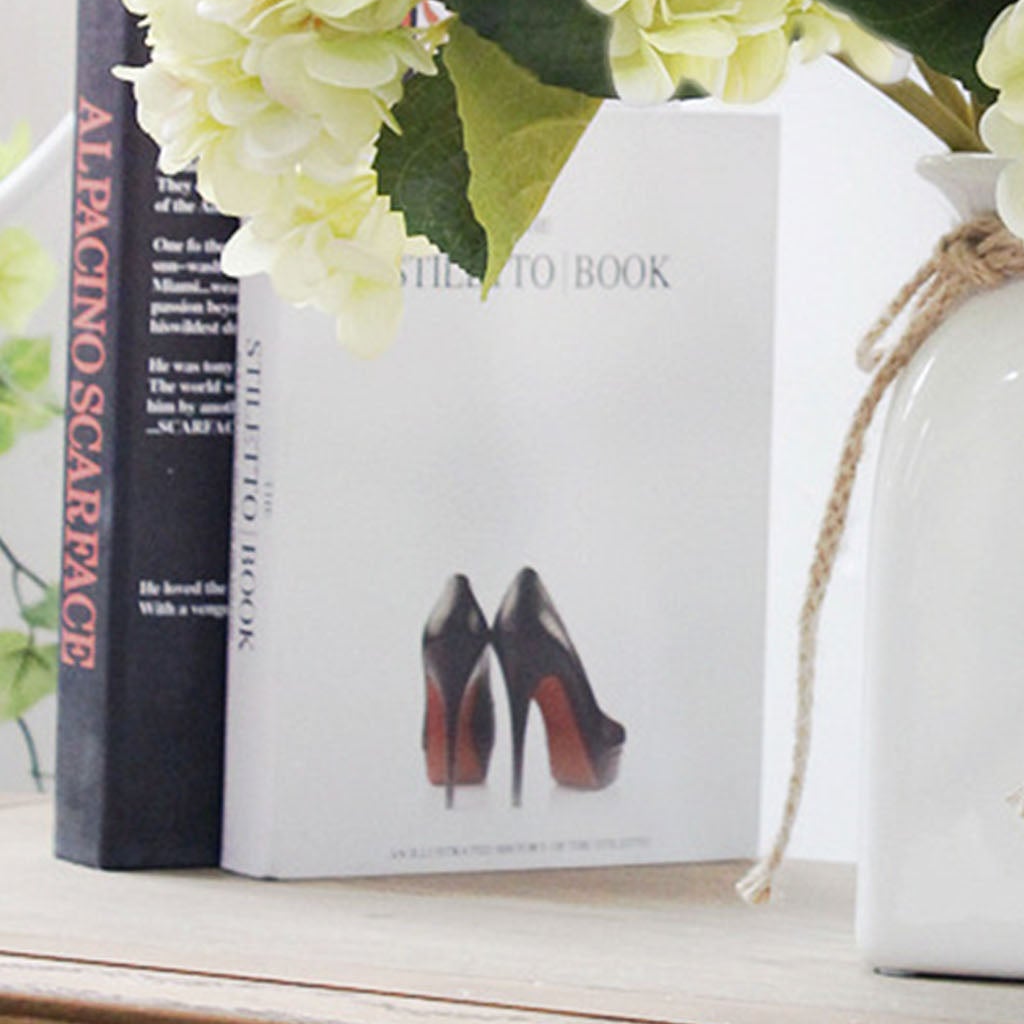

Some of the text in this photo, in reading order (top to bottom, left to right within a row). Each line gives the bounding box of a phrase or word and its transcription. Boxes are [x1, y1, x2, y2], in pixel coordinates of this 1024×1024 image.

[153, 197, 171, 213] of
[172, 197, 196, 213] the
[152, 236, 184, 254] One
[574, 253, 671, 290] BOOK
[149, 298, 204, 317] passion
[148, 357, 170, 374] He
[172, 362, 200, 374] was
[148, 378, 176, 394] The
[179, 378, 221, 394] world
[146, 398, 176, 414] him
[178, 398, 196, 418] by
[60, 379, 105, 670] SCARFACE
[139, 579, 160, 596] He
[163, 579, 203, 596] loved
[238, 544, 256, 652] BOOK
[139, 601, 176, 617] With
